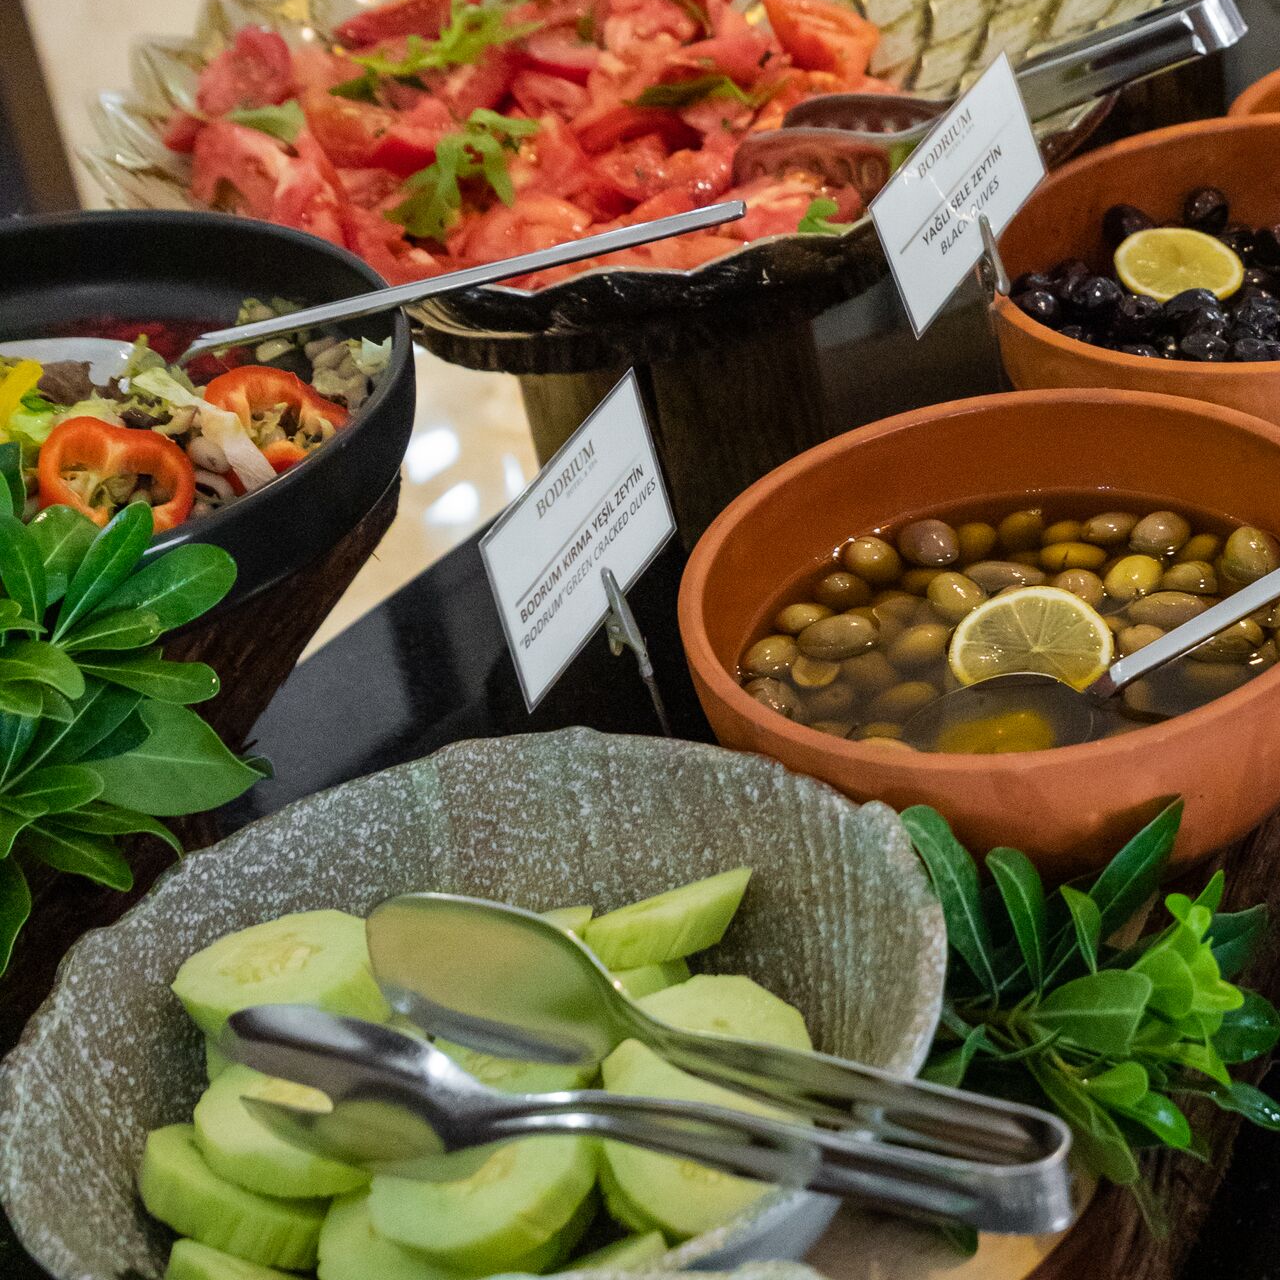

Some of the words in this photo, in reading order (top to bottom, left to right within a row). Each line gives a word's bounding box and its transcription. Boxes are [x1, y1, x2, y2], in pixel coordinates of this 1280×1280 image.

[916, 106, 972, 180] BODRIUM
[920, 203, 951, 248] YAĞLI
[949, 180, 971, 213] SELE
[969, 140, 1002, 188] ZEYTİN
[534, 438, 595, 520] BODRIUM
[592, 508, 630, 562] CRACKED
[628, 474, 657, 518] OLIVES
[518, 562, 563, 625] BODRUM
[561, 525, 593, 572] KIRMA
[590, 494, 616, 537] YEŞİL
[612, 459, 644, 507] ZEYTİN
